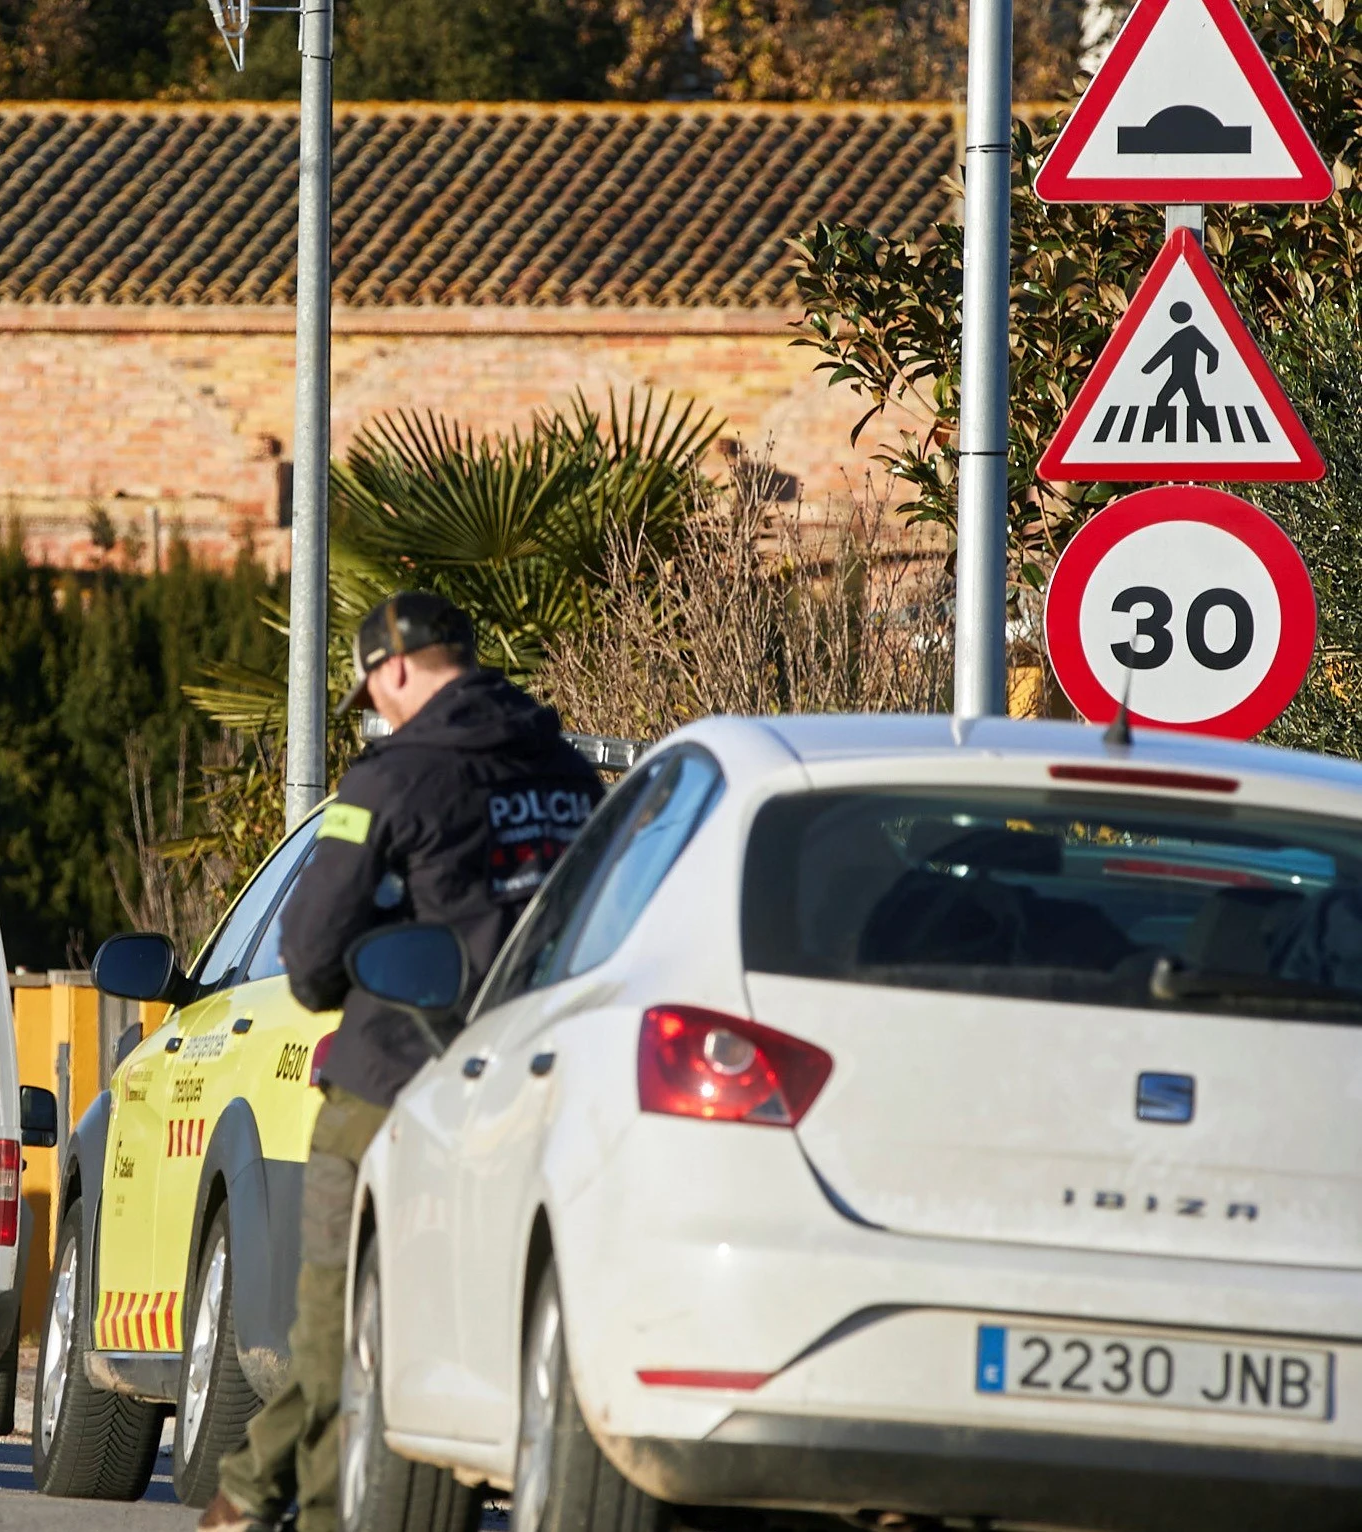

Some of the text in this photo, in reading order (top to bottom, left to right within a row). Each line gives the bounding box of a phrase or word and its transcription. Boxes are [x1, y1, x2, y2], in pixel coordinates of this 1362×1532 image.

[1110, 586, 1255, 671] 30
[491, 790, 591, 827] POLCIA
[1063, 1188, 1259, 1222] IBIZA
[1020, 1336, 1175, 1398] 2230
[1201, 1351, 1312, 1410] JNB
